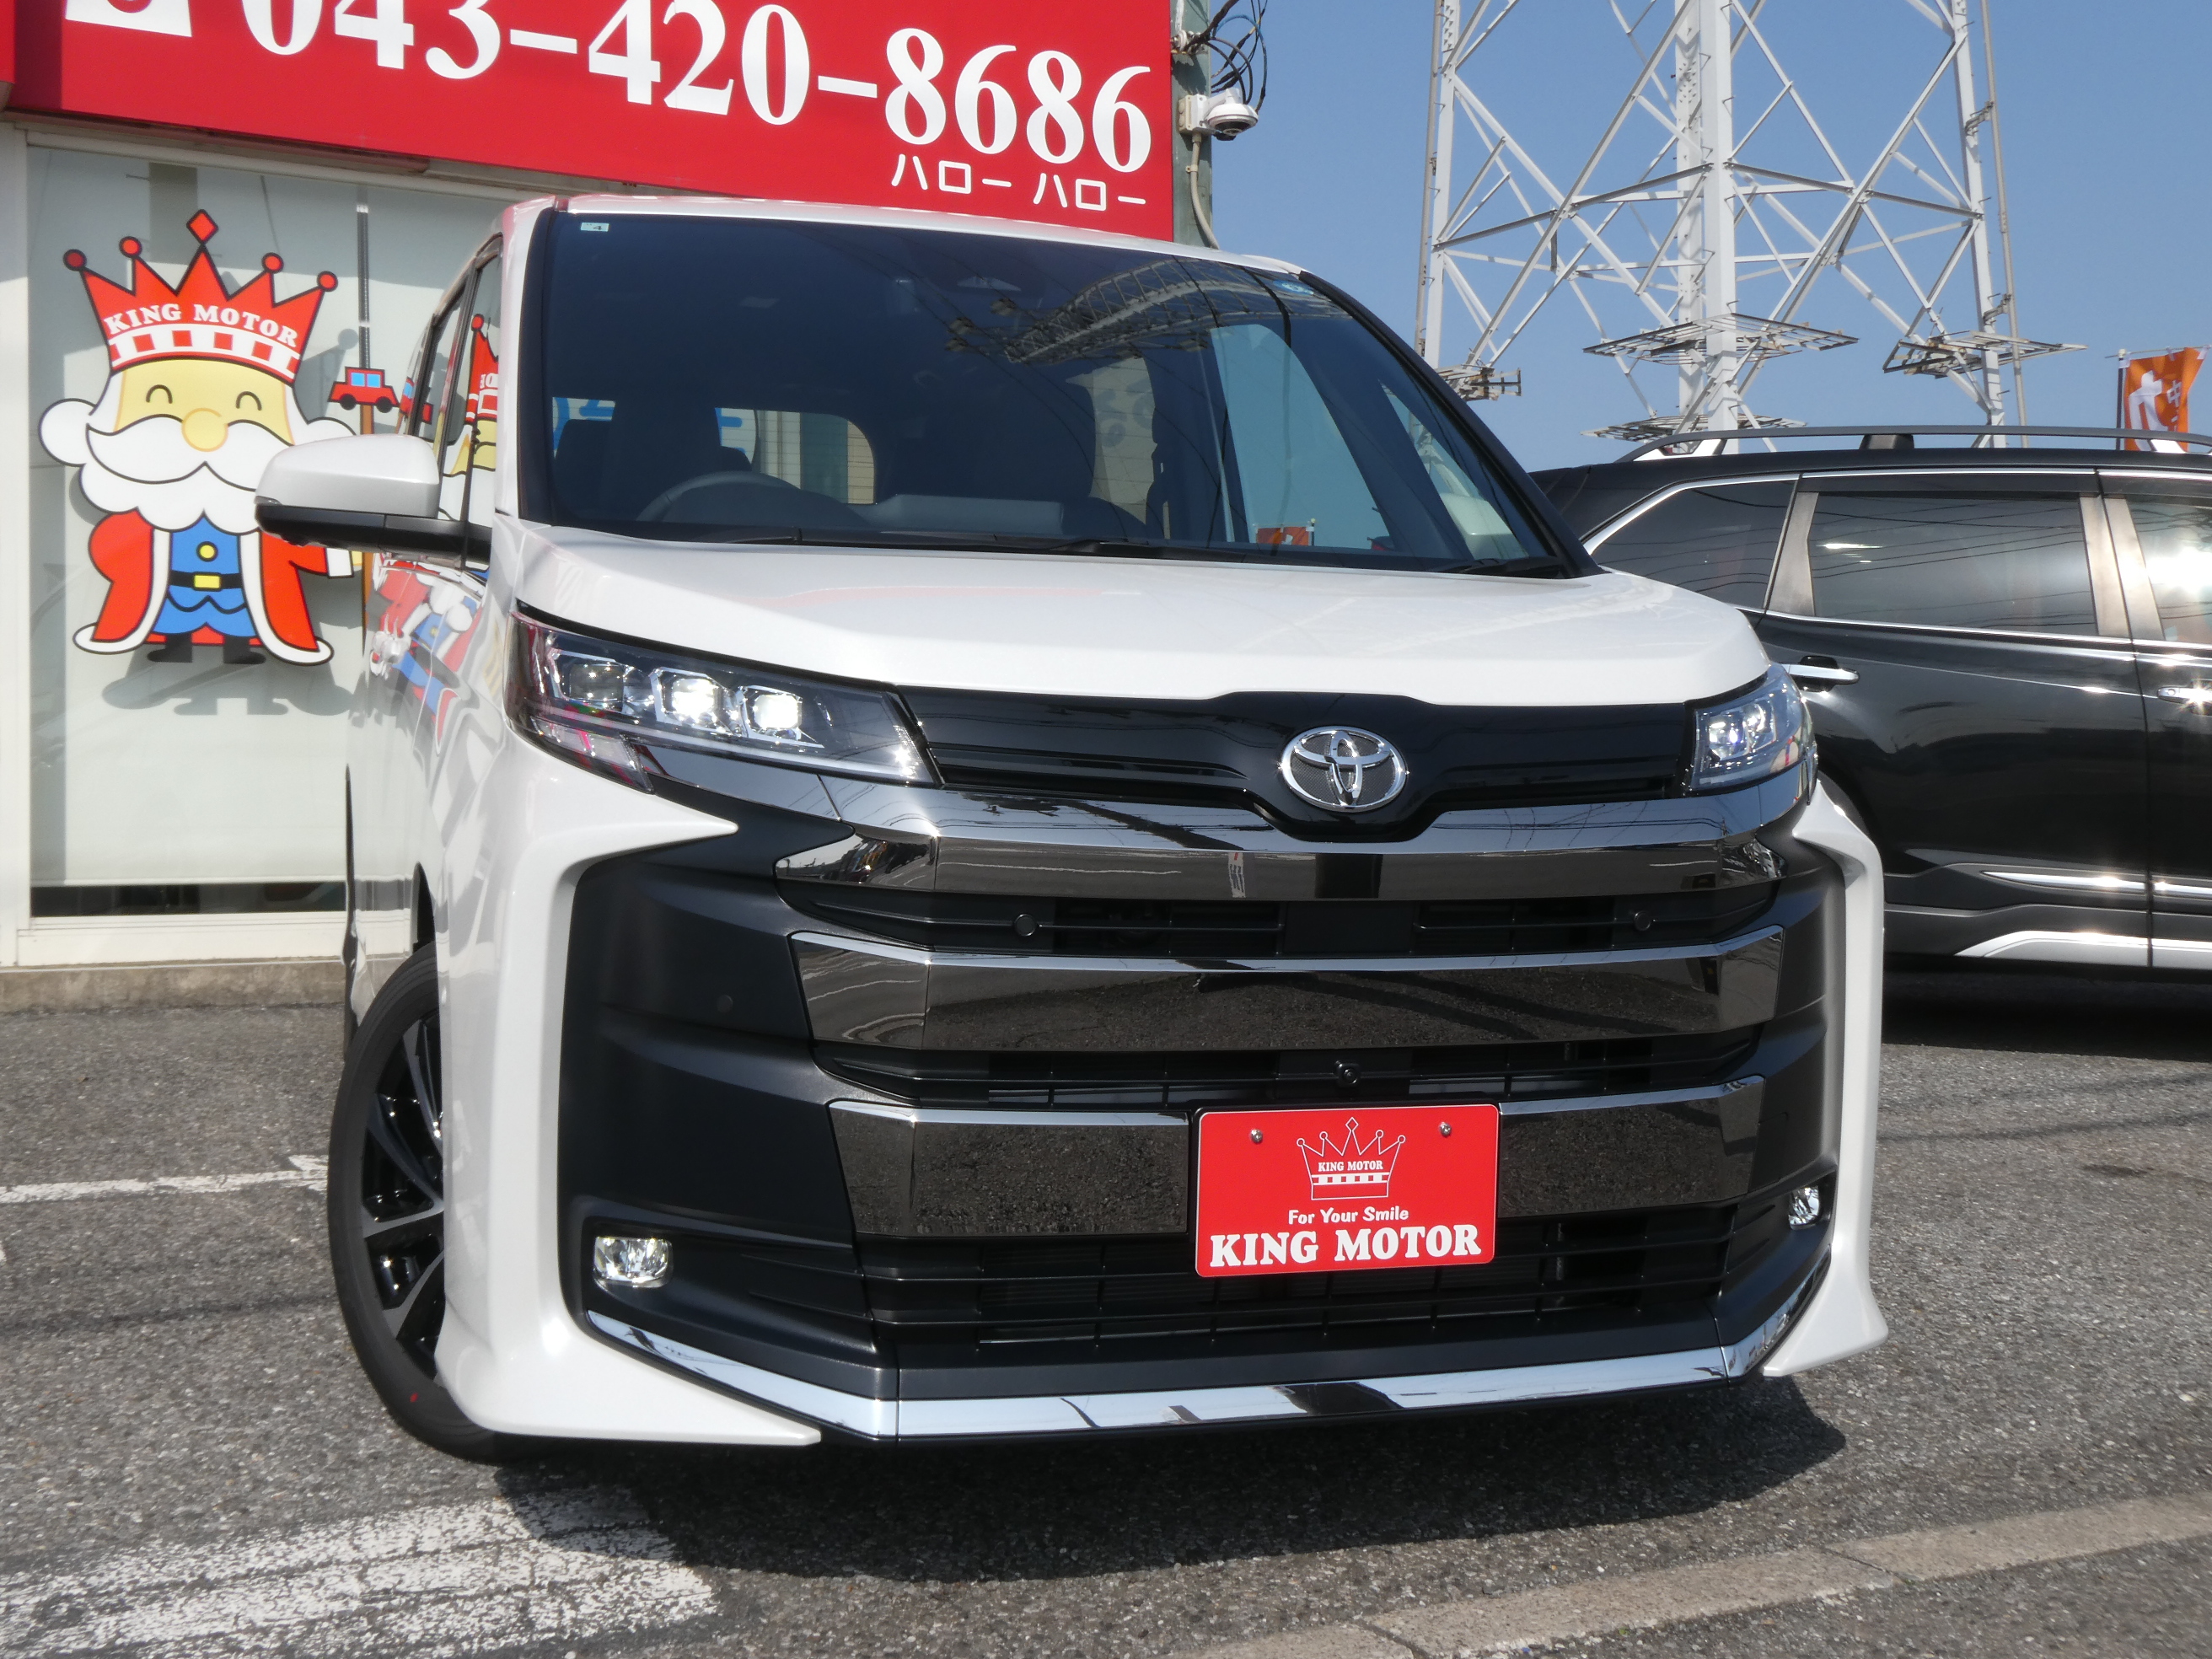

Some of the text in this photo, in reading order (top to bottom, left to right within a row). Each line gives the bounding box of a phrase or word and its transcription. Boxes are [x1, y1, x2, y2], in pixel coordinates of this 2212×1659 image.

[891, 153, 1146, 212] ハロー ハロー
[103, 303, 298, 348] KING MOTOR
[1318, 1159, 1384, 1173] KING MOTOR
[1288, 1205, 1409, 1225] For Your Smile
[1210, 1224, 1482, 1268] KING MOTOR
